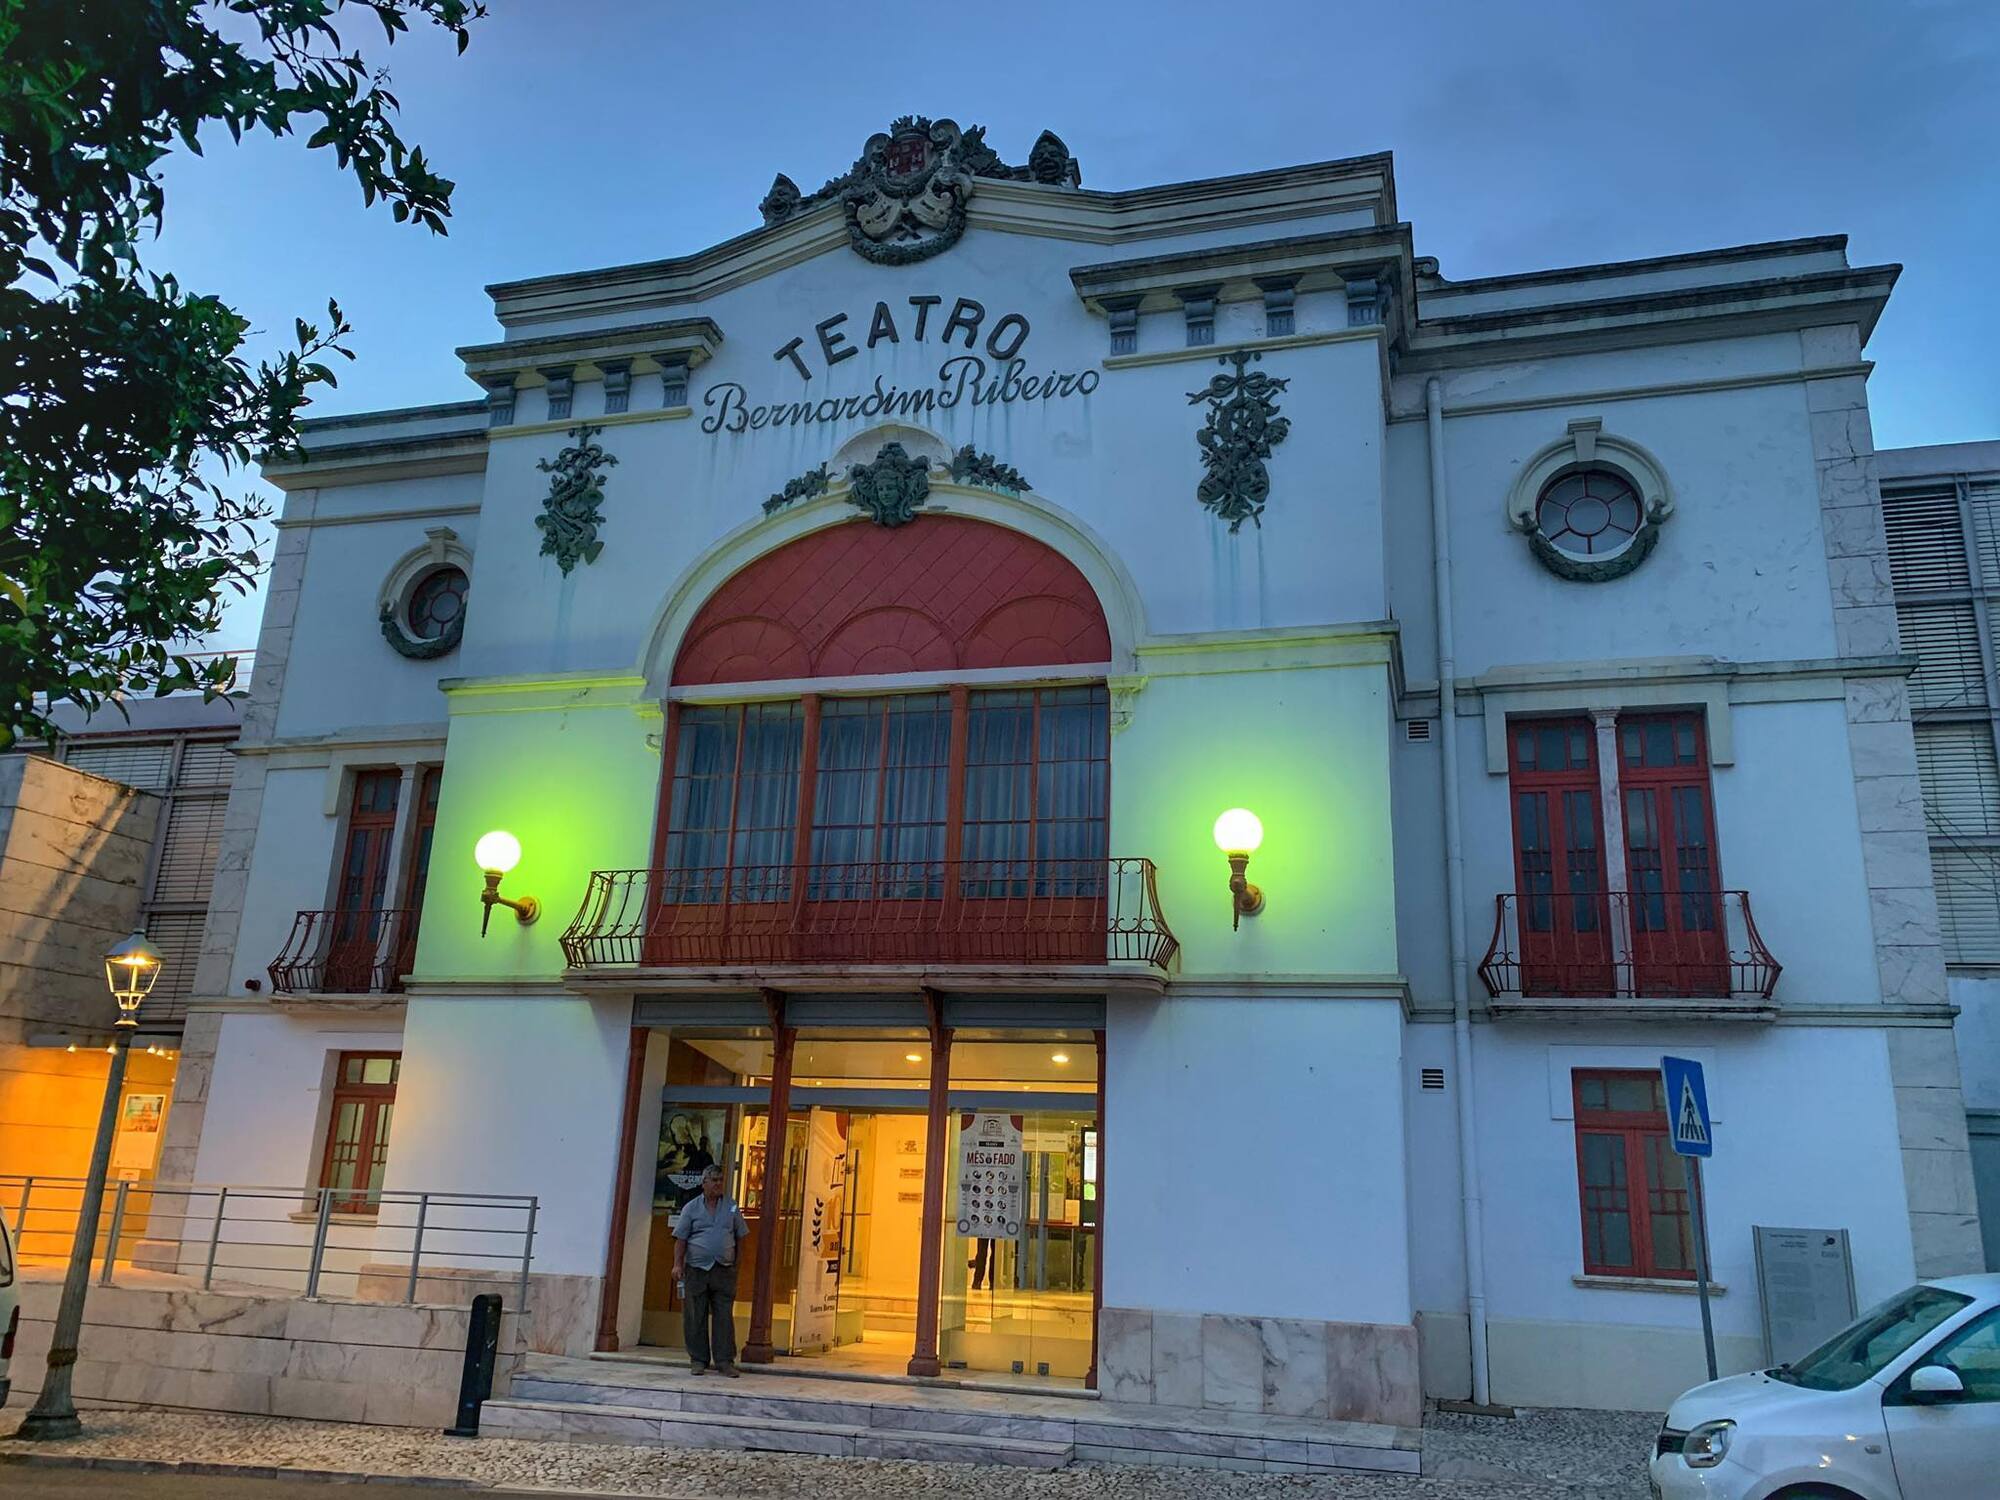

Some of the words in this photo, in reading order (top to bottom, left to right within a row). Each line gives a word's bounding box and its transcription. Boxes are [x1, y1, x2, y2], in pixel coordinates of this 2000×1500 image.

[773, 295, 1030, 381] TEATRO
[701, 374, 935, 434] Bernardim
[938, 355, 1100, 408] Ribeiro
[966, 1150, 985, 1165] MÊS
[993, 1152, 1016, 1166] FADO
